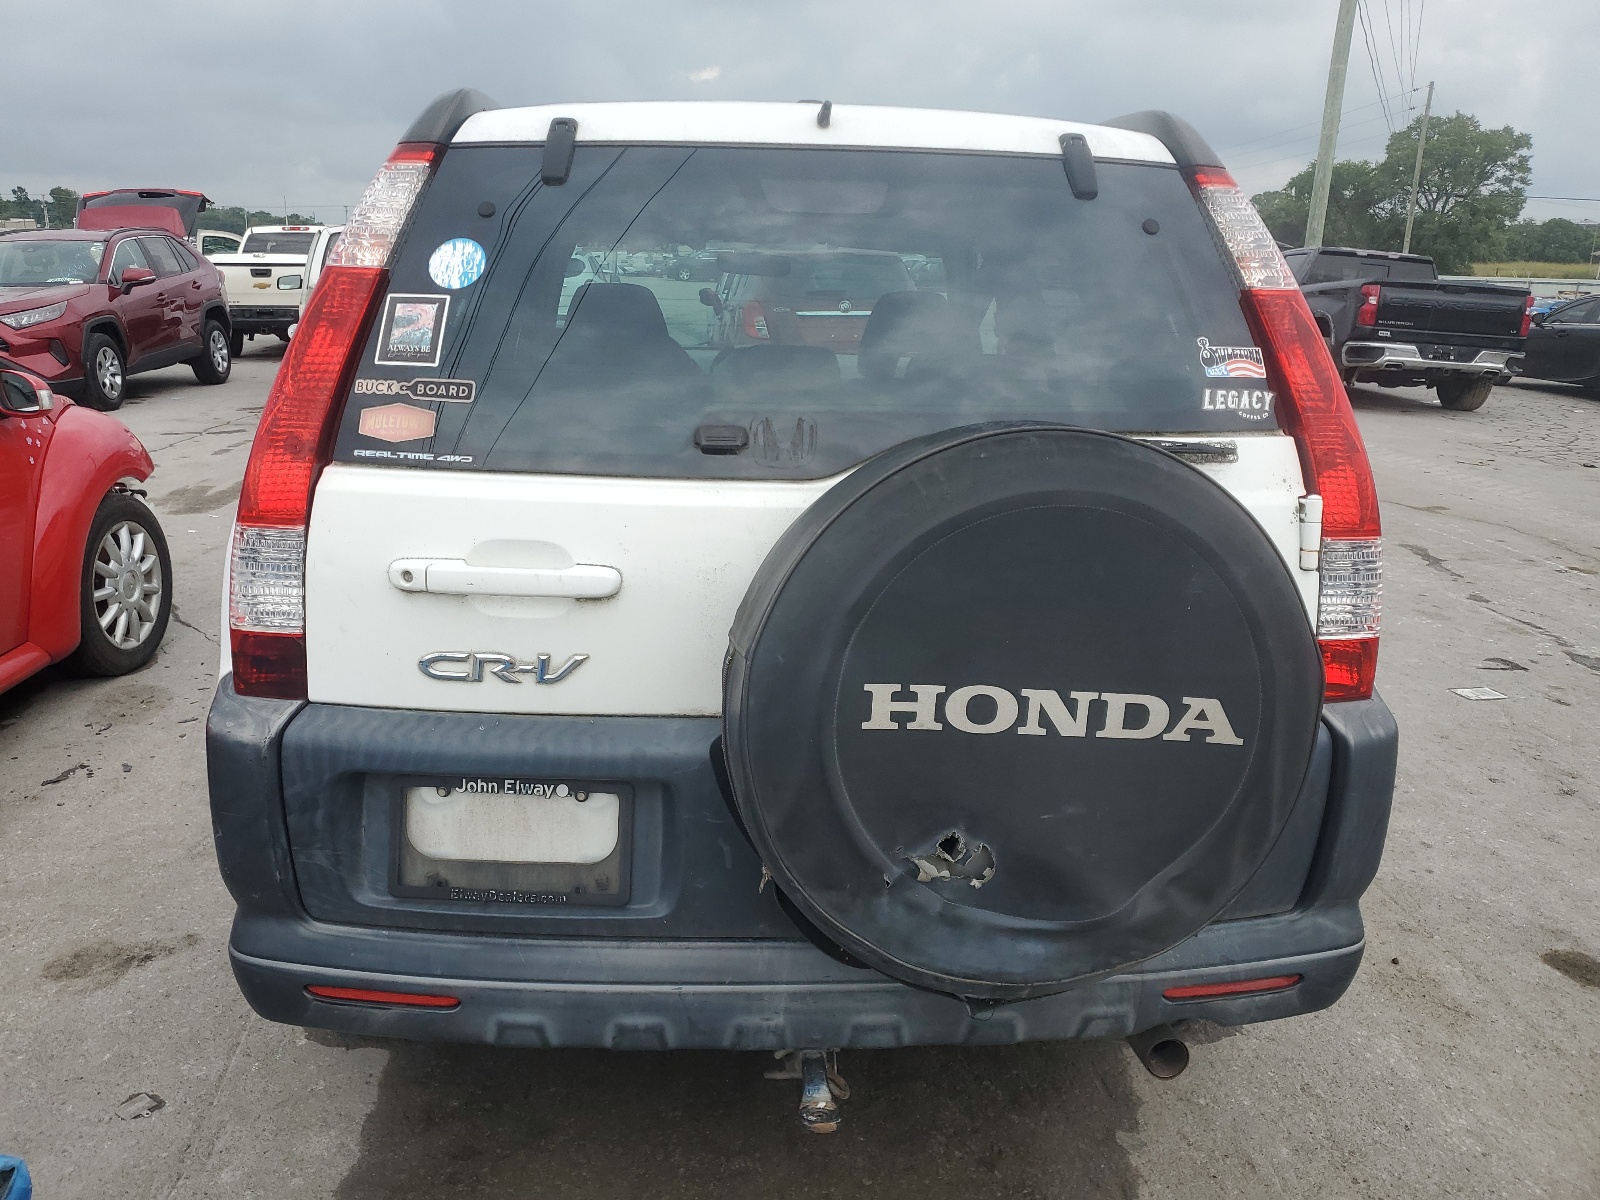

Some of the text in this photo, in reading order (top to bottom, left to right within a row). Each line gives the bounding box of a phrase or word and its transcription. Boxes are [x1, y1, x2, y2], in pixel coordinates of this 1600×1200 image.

[387, 344, 431, 353] ALWAYS BE
[356, 381, 469, 397] BUCK BOARD
[1202, 389, 1274, 412] LEGACY
[436, 454, 474, 463] 4WD
[418, 651, 590, 684] CR-V
[861, 683, 1244, 746] HONDA
[455, 778, 555, 800] John Elway
